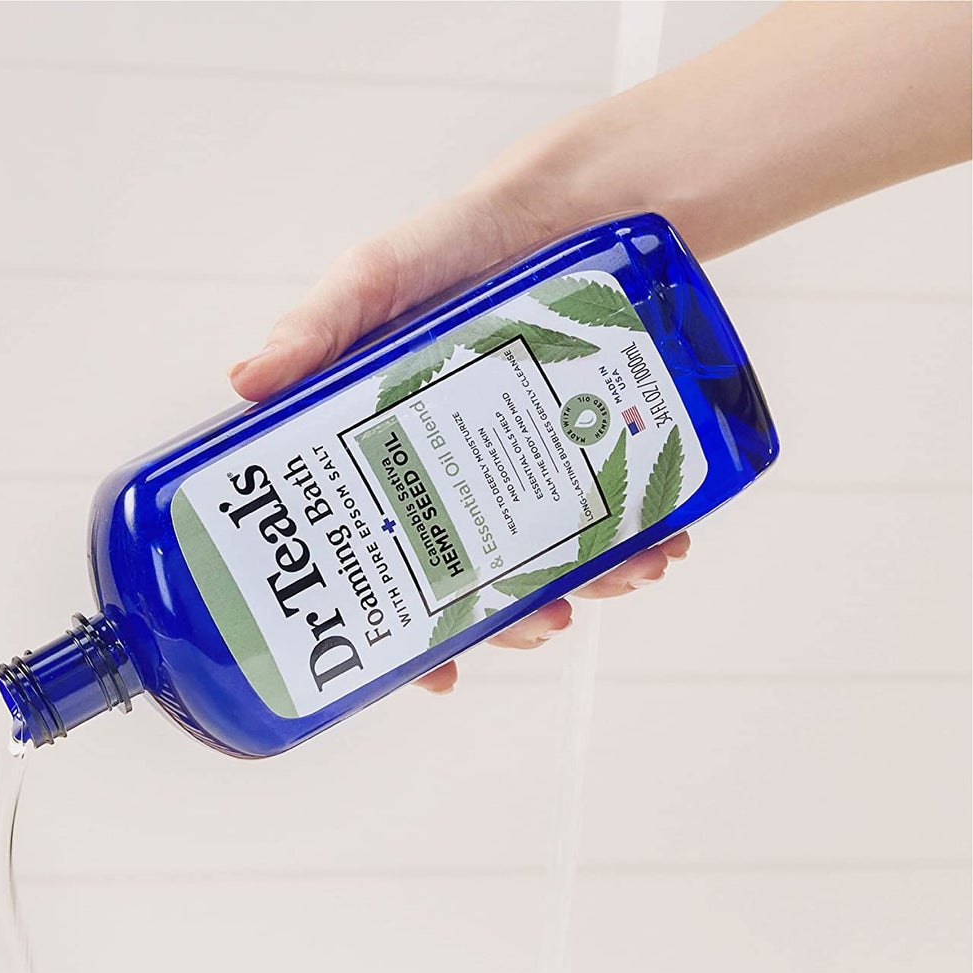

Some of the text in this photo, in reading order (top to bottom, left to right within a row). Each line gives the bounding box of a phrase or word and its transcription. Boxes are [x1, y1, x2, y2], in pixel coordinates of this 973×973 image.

[562, 406, 586, 444] MADE WITH
[593, 399, 608, 417] SEED
[594, 418, 608, 439] HEMP
[598, 365, 623, 404] MADE IN
[612, 368, 626, 391] USA
[408, 399, 504, 570] & Essential Oil Blend
[451, 411, 518, 536] HELPS TO DEEPLY MOISTURIZE
[477, 427, 520, 502] AND SOOTHE SKIN
[495, 411, 544, 500] ESSENTIAL OILS HELP
[502, 392, 561, 502] CALM THE BODY AND MIND
[503, 349, 594, 522] LONG-LASTING BUBBLES GENTLY CLEANSE
[283, 454, 392, 647] Foaming Bath
[311, 445, 412, 628] WITH PURE EPSOM SALT
[381, 456, 441, 567] Cannabis Sativa
[384, 431, 465, 578] HEMP SEED OIL
[305, 607, 364, 693] Dr
